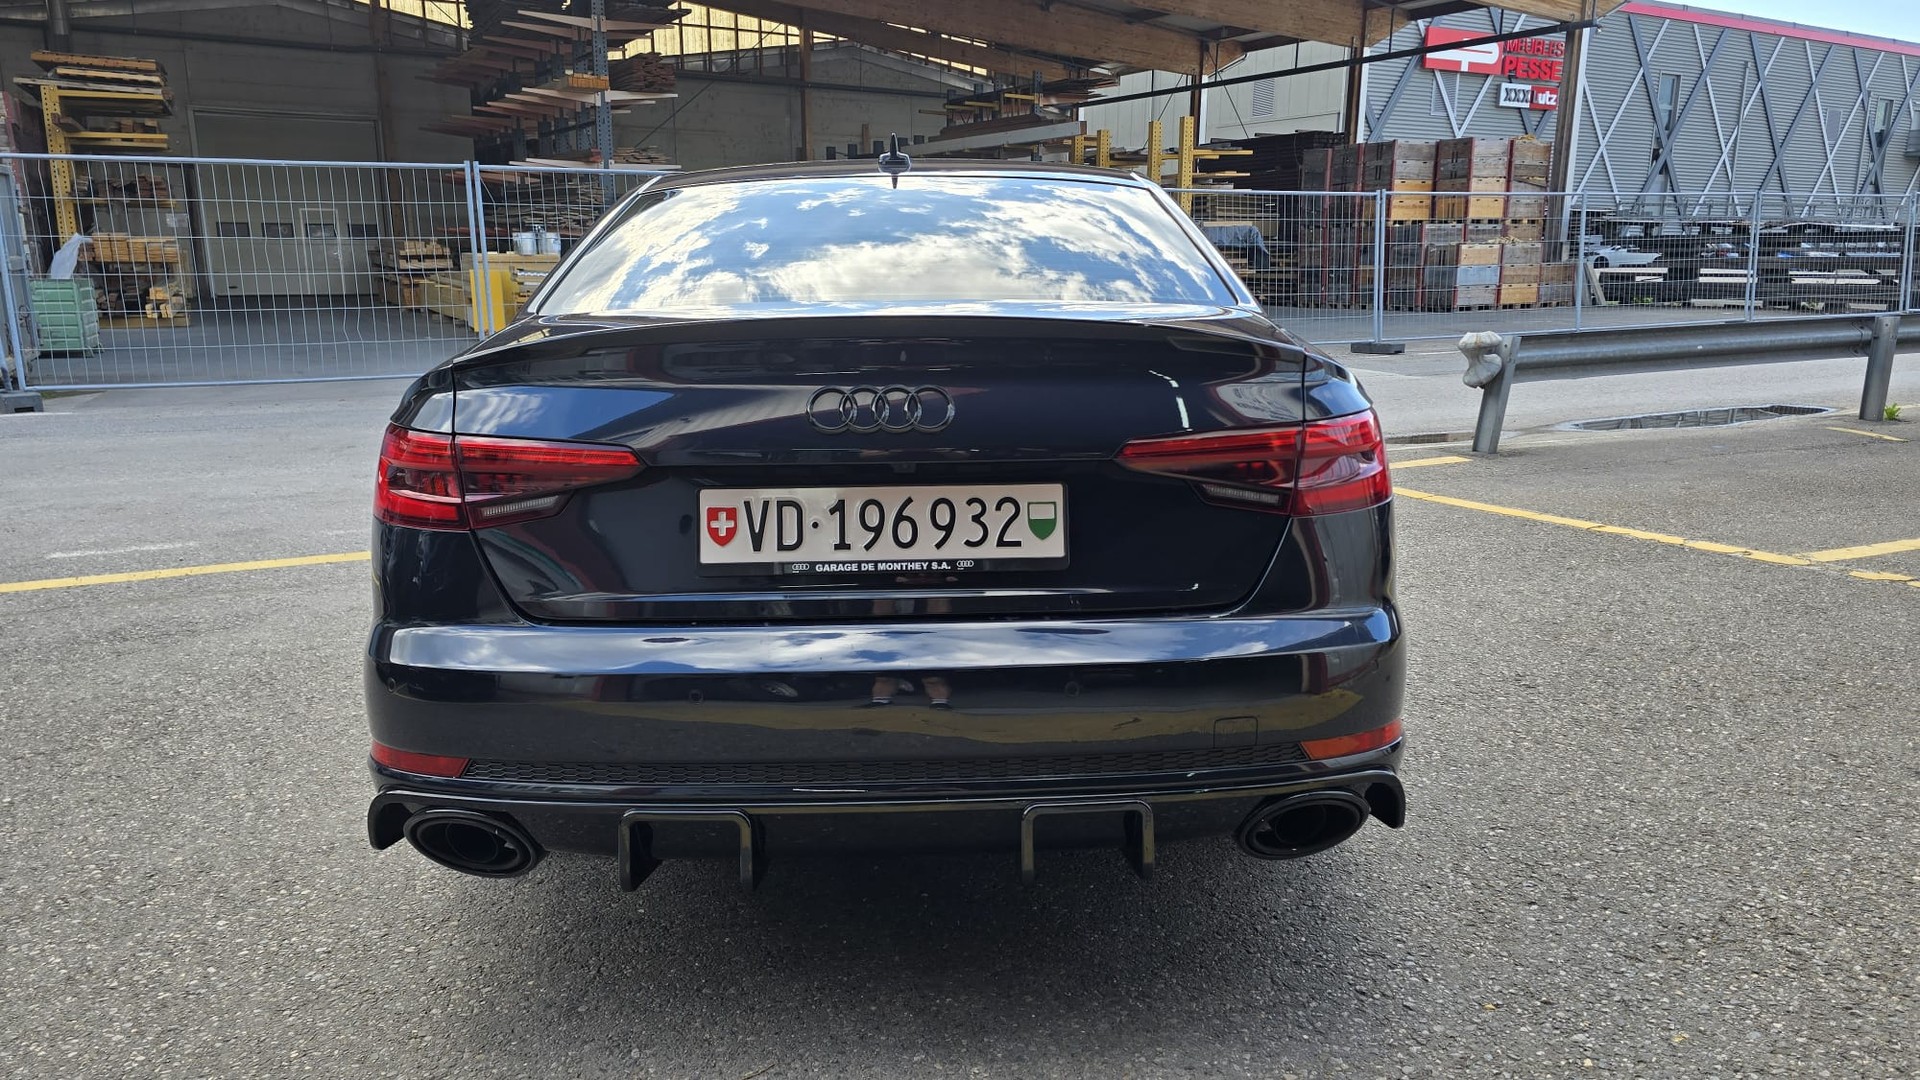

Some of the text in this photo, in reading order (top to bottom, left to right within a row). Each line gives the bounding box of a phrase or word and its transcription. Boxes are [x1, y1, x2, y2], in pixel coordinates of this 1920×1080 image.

[1502, 55, 1563, 81] PESSE
[815, 561, 951, 572] GARAGE DE MONTHEY S.A.
